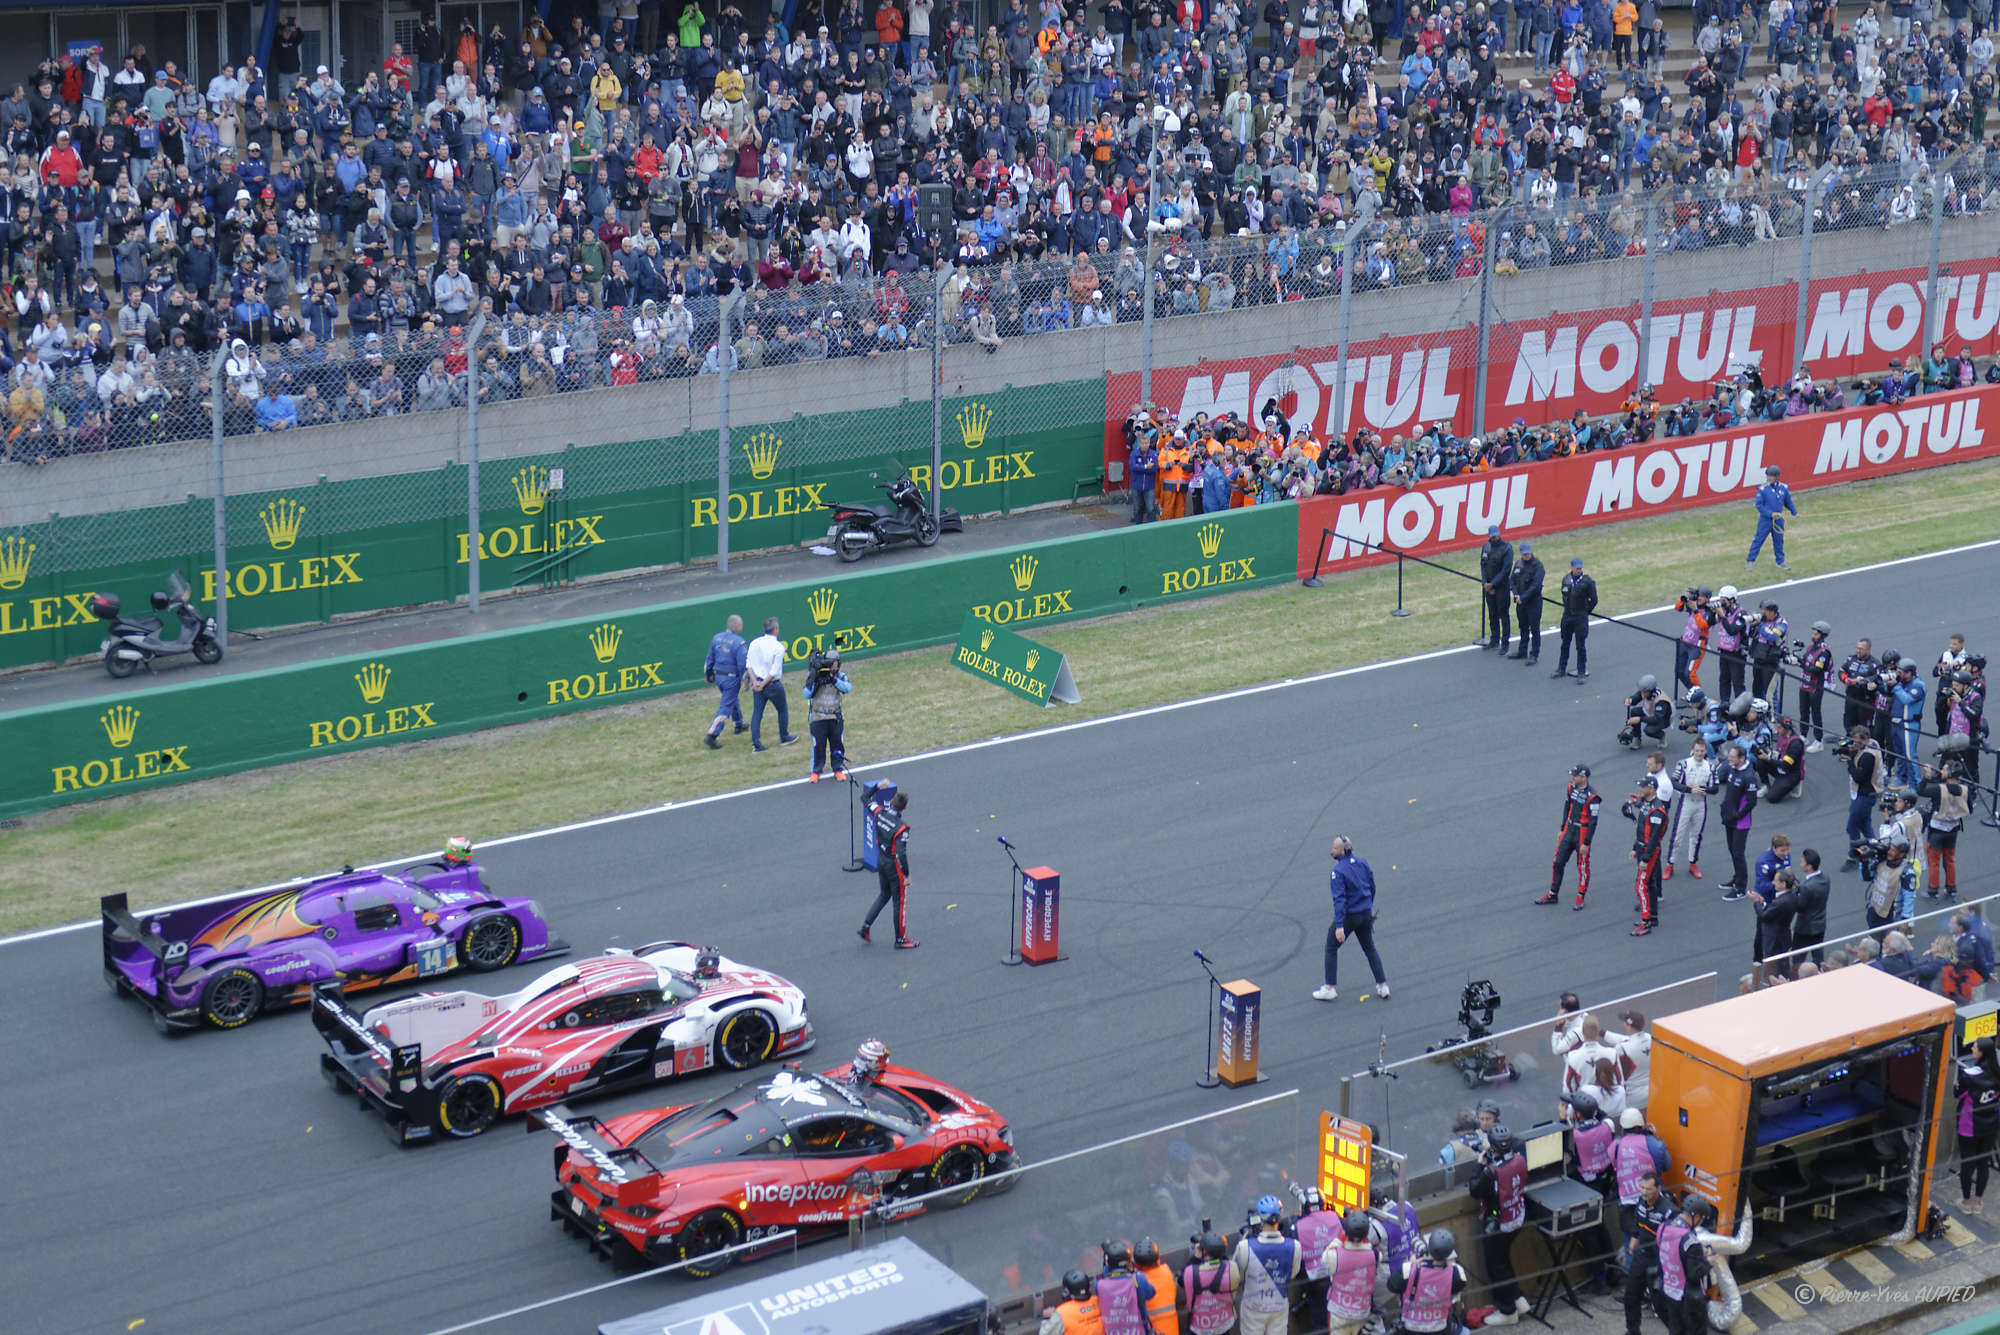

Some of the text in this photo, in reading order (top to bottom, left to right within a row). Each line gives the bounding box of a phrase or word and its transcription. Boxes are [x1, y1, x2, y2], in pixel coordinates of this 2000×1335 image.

[1802, 263, 2000, 362] MOTU
[1504, 305, 1763, 407] MOTUL
[1175, 347, 1461, 440] MOTUL
[1813, 398, 1985, 475] MOTUL
[910, 451, 1035, 491] ROLEX
[1582, 434, 1767, 515] MOTUL
[690, 482, 830, 527] ROLEX
[1327, 473, 1536, 561] MOTUL
[456, 515, 606, 564] ROLEX
[200, 552, 363, 602] ROLEX
[1162, 556, 1256, 595] ROLEX
[0, 592, 99, 635] LEX
[547, 661, 664, 705] ROLEX
[957, 646, 1047, 699] ROLEX ROLEX
[309, 701, 437, 747] ROLEX
[51, 745, 191, 793] ROLEX
[421, 946, 443, 973] 14
[682, 1049, 697, 1069] 6
[744, 1180, 848, 1208] inception
[797, 1209, 844, 1223] GOODYEAR
[760, 1261, 899, 1311] UNITED
[770, 1272, 905, 1321] AUTOSPORTS
